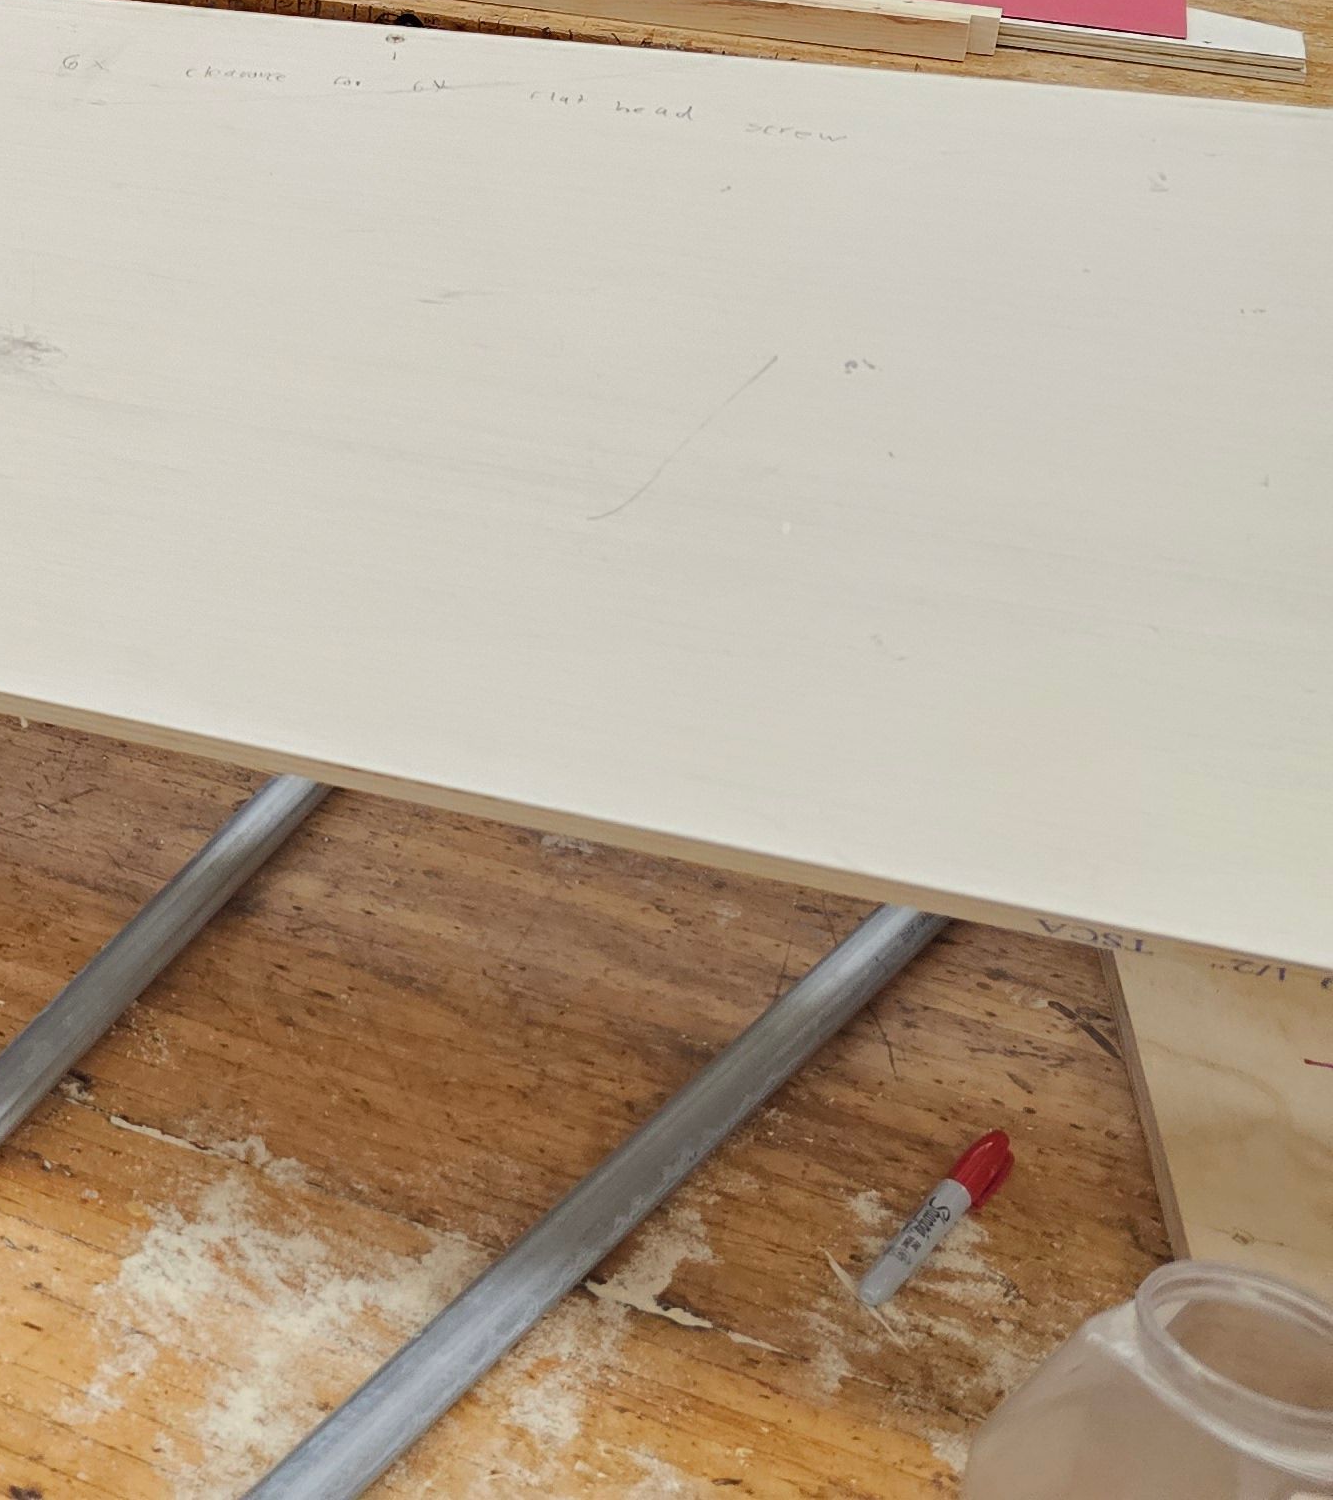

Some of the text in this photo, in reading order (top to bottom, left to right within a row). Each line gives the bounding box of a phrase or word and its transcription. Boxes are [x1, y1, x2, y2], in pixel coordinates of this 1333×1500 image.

[615, 100, 694, 122] head
[745, 122, 849, 143] screw
[1037, 917, 1154, 956] TSCA
